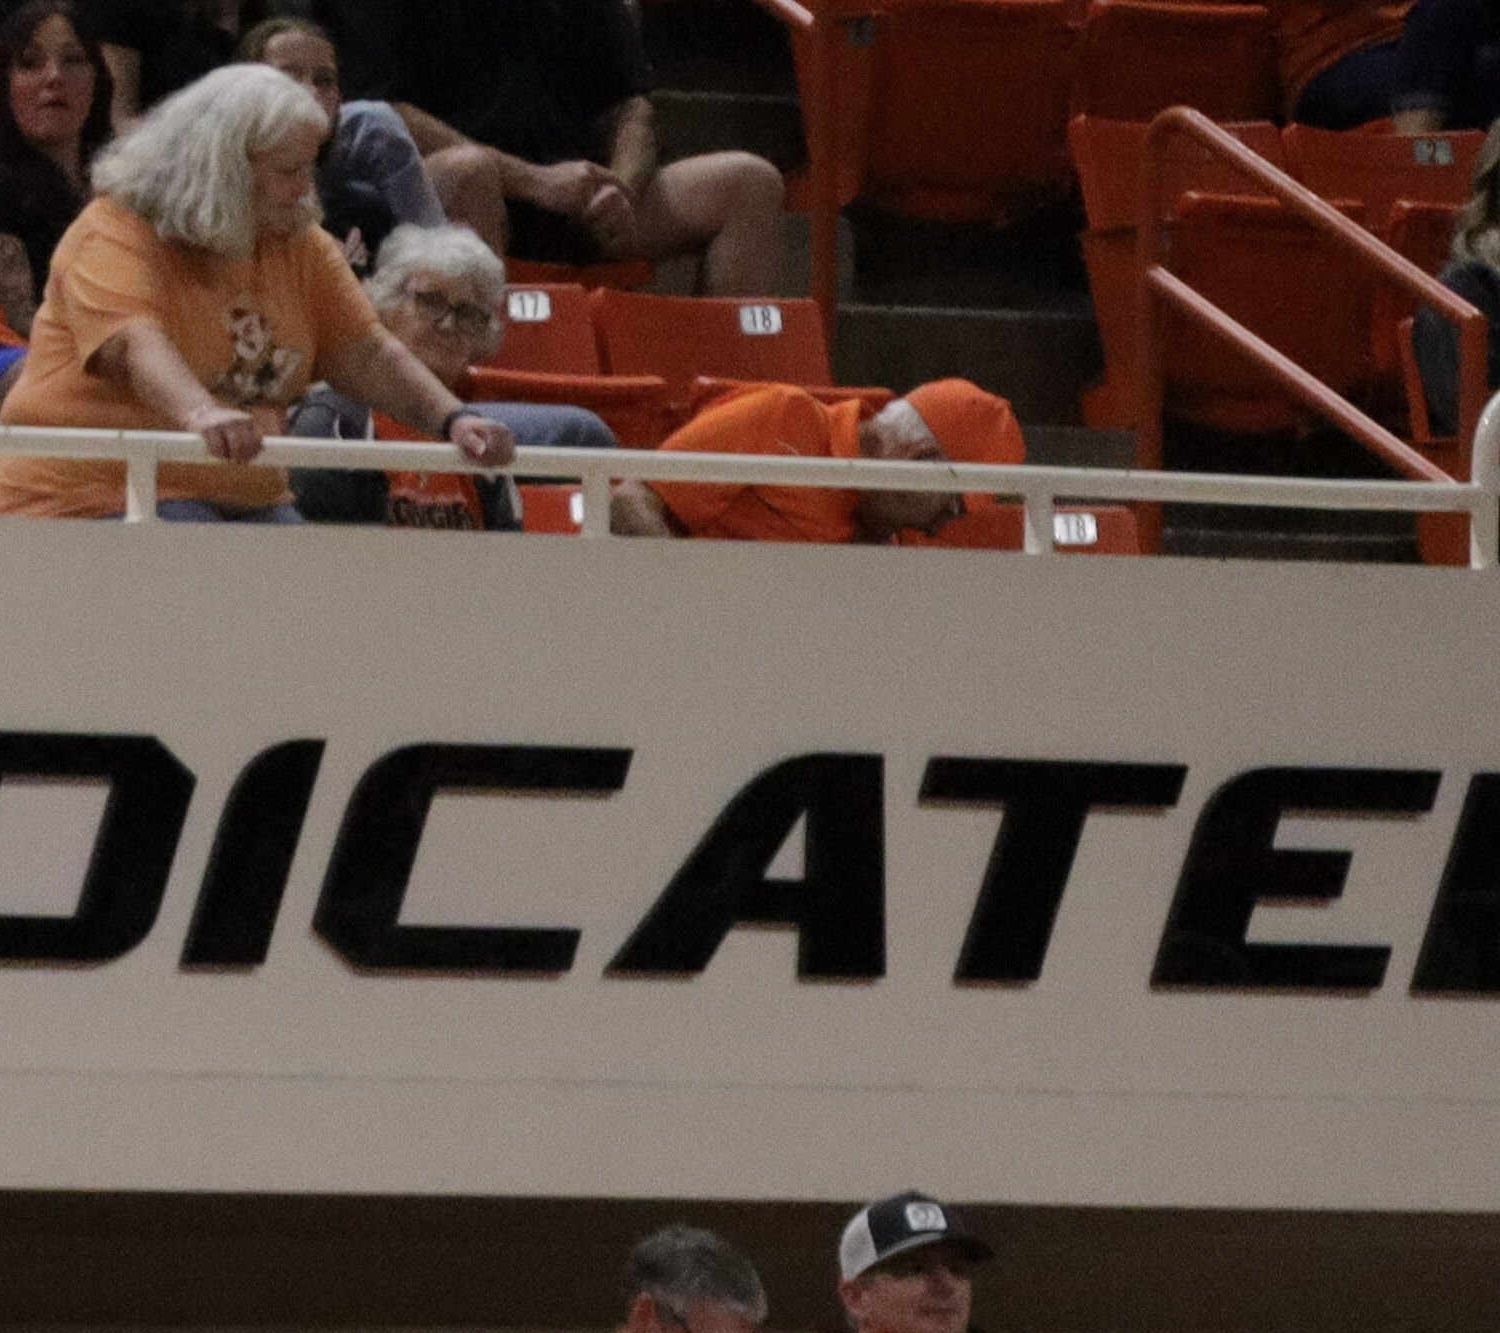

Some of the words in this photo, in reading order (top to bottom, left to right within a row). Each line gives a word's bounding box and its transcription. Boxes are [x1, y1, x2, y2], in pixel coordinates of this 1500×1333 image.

[518, 294, 540, 318] 17
[749, 307, 772, 331] 18
[1065, 515, 1088, 541] 18
